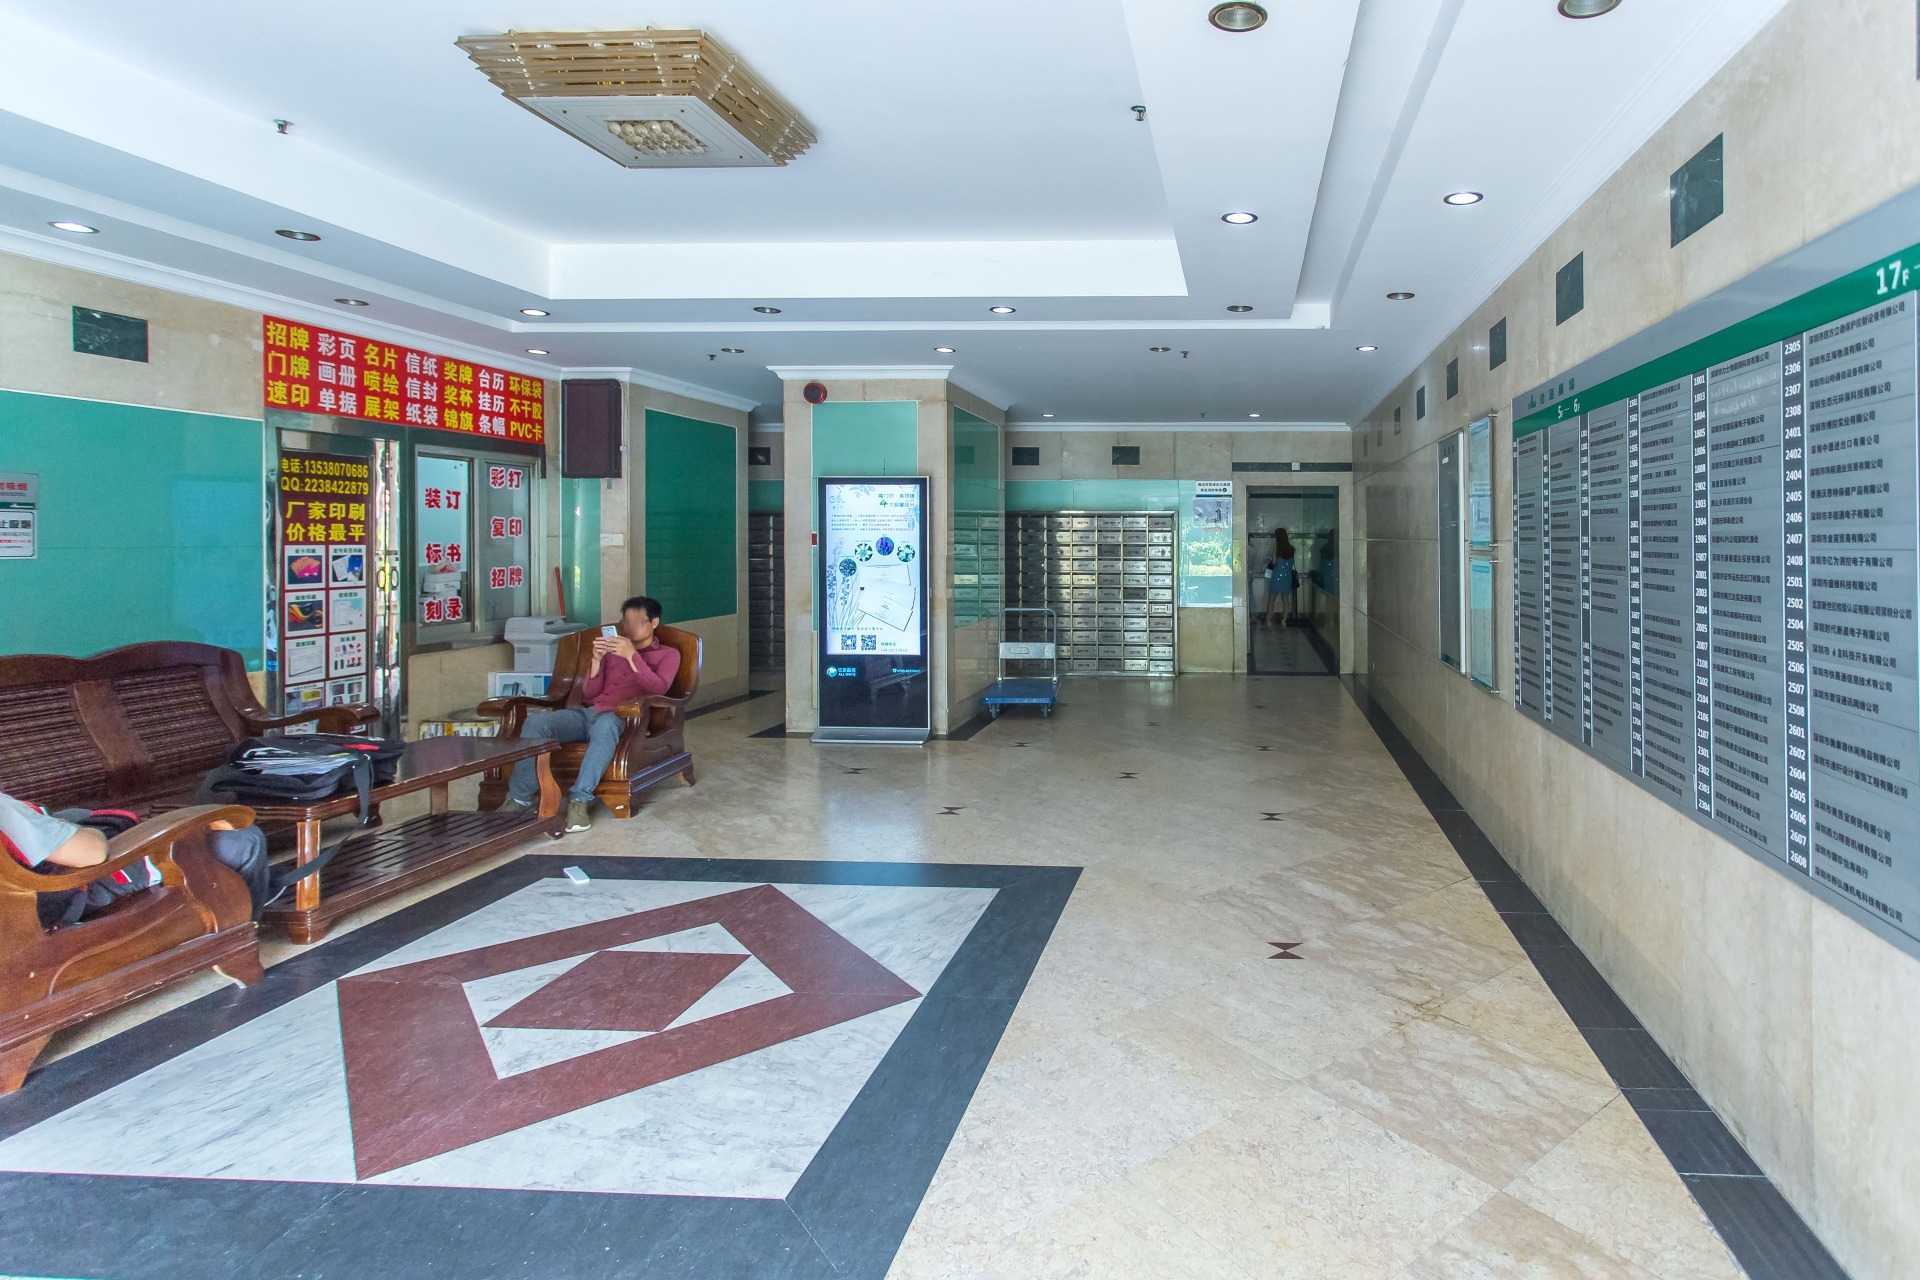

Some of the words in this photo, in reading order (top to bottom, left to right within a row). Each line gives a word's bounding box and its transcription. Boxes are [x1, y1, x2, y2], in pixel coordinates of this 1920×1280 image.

[1784, 340, 1800, 354] 2305
[267, 321, 310, 351] 招牌
[318, 333, 356, 361] 彩页
[364, 344, 398, 370] 名片
[405, 353, 437, 378] 信纸
[444, 362, 472, 384] 奖牌
[479, 369, 504, 391] 台历
[510, 376, 541, 399] 环保袋
[1785, 361, 1800, 375] 2306
[268, 351, 310, 379] 门牌
[318, 361, 357, 388] 画册
[364, 371, 399, 396] 喷绘
[405, 378, 437, 402] 信封
[444, 385, 472, 408] 奖杯
[479, 392, 504, 413] 挂历
[510, 398, 542, 420] 不干胶
[1785, 383, 1800, 396] 2307
[267, 380, 310, 407] 速印
[318, 389, 357, 415] 单据
[364, 395, 399, 420] 展架
[406, 402, 438, 426] 纸袋
[444, 409, 473, 432] 锦旗
[479, 415, 505, 436] 条幅
[510, 421, 542, 441] PVC卡
[1785, 404, 1801, 417] 2308
[1785, 426, 1800, 438] 2401
[1785, 448, 1801, 459] 2402
[281, 458, 368, 478] 电话:13538070686
[1786, 469, 1801, 480] 2404
[490, 468, 522, 488] 彩打
[281, 476, 369, 495] QQ:2238422879
[425, 488, 461, 510] 装订
[1786, 490, 1801, 501] 2405
[286, 501, 365, 520] 厂家印刷
[1786, 512, 1801, 522] 2406
[286, 523, 366, 542] 价格最平
[491, 518, 522, 538] 复印
[1786, 533, 1802, 543] 2407
[426, 543, 461, 564] 标书
[1786, 555, 1802, 565] 2408
[491, 567, 522, 588] 招牌
[1787, 576, 1802, 586] 2501
[425, 597, 461, 622] 刻录
[1787, 597, 1802, 608] 2502
[1787, 618, 1803, 629] 2504
[1787, 639, 1803, 651] 2505
[1788, 661, 1804, 673] 2506
[1788, 681, 1803, 694] 2507
[1788, 703, 1804, 716] 2508
[1788, 724, 1804, 738] 2601
[1789, 745, 1804, 759] 2602
[1789, 766, 1805, 781] 2604
[1789, 787, 1805, 802] 2605
[1790, 808, 1805, 824] 2606
[1790, 829, 1805, 845] 2607
[1790, 850, 1806, 867] 2608
